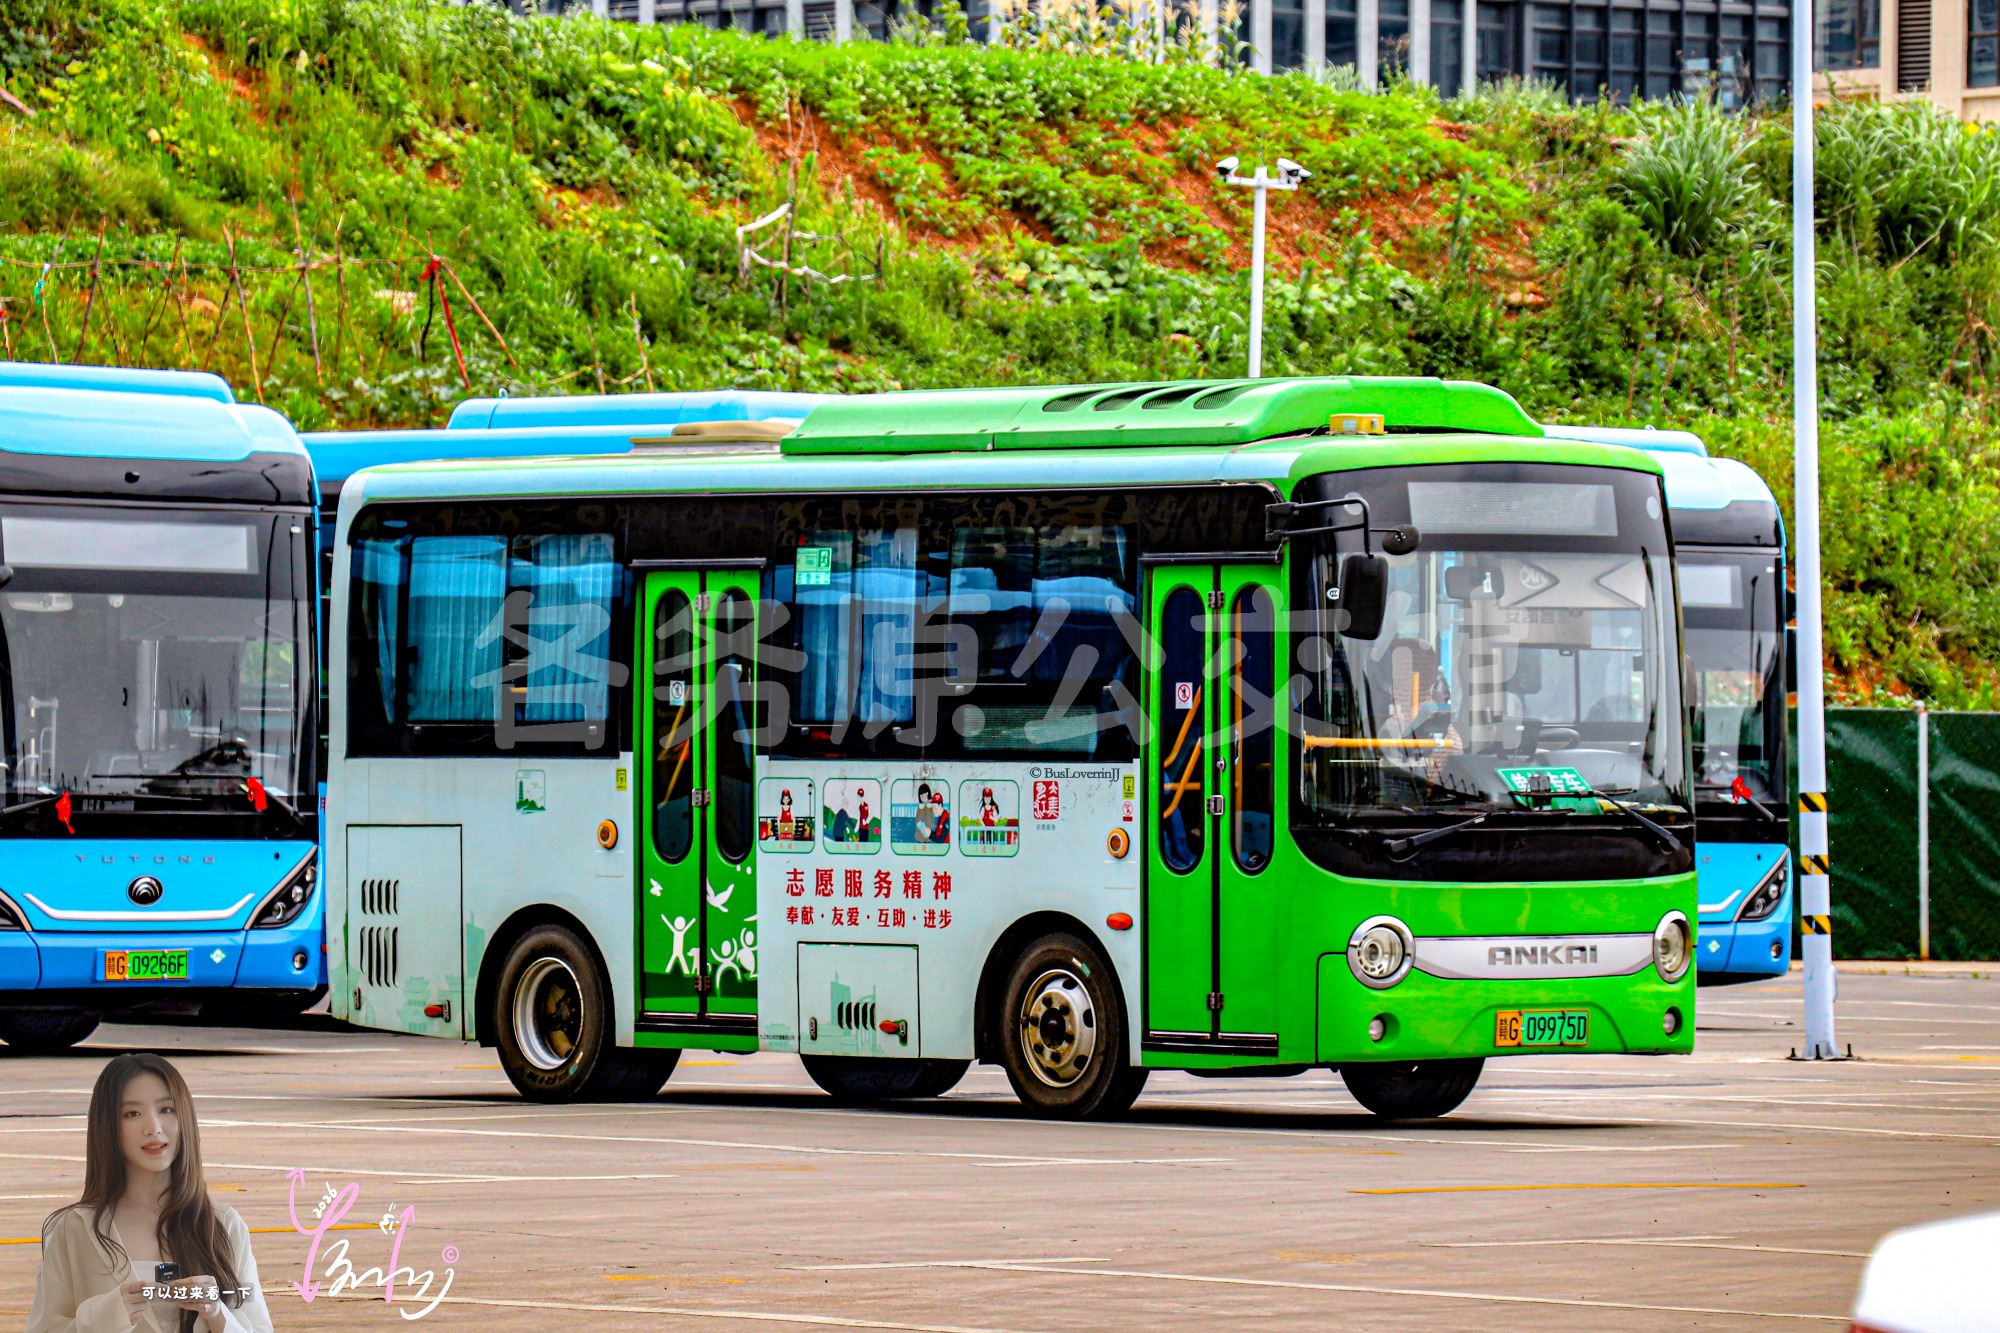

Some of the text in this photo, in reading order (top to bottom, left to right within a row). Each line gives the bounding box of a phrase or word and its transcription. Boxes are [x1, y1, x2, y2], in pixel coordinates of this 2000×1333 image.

[76, 854, 215, 864] YUTONG
[785, 867, 952, 900] 志愿服务精神
[1487, 945, 1598, 966] ANKAI
